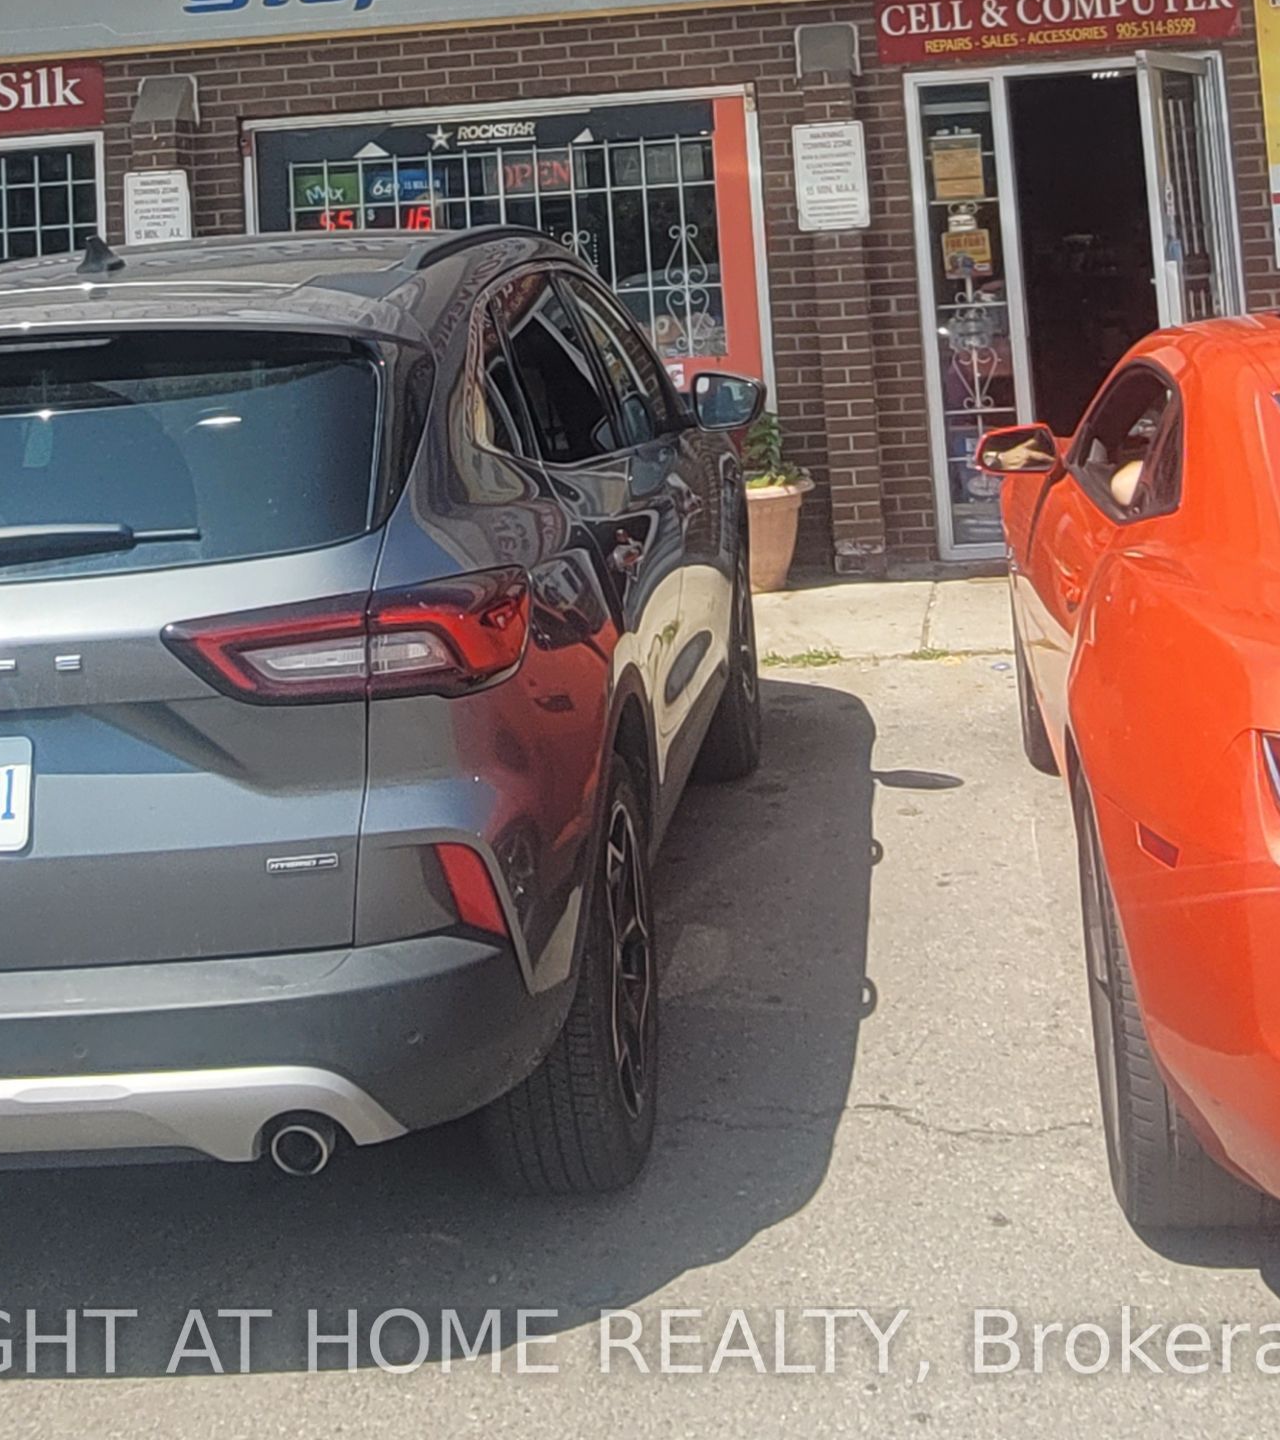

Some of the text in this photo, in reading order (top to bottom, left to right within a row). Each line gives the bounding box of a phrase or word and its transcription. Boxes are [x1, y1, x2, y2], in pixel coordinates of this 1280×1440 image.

[881, 2, 972, 36] CELL
[925, 37, 972, 54] REPAIRS
[981, 34, 1018, 49] SALES
[1028, 26, 1108, 45] ACCESSORIES
[1116, 18, 1197, 38] 905-514-8599
[457, 121, 536, 140] ROCKSTAR
